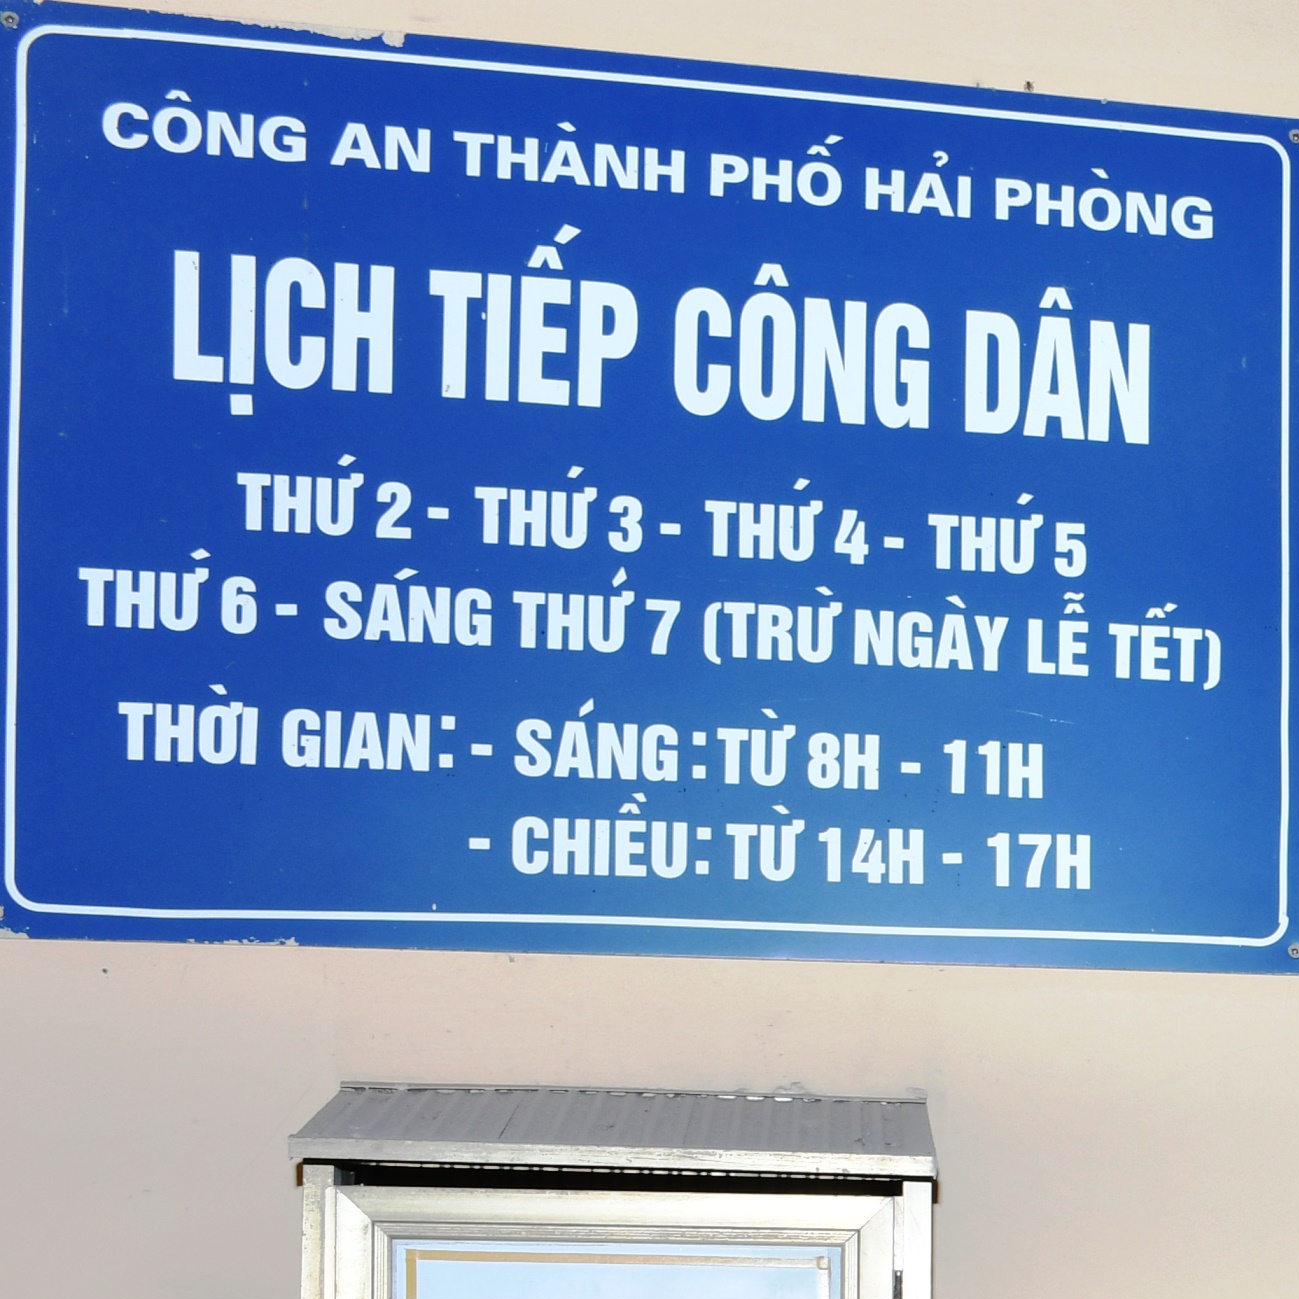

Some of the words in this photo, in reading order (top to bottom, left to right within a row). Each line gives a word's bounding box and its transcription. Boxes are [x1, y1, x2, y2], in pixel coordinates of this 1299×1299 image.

[103, 90, 306, 161] CÔNG
[331, 123, 430, 172] AN
[454, 123, 684, 193] THÀNH
[710, 135, 842, 206] PHỐ
[866, 151, 971, 218] HẢI
[996, 169, 1213, 239] PHÒNG
[174, 251, 394, 415] LỊCH
[430, 224, 638, 407] TIẾP
[674, 263, 929, 428] CÔNG
[965, 287, 1150, 444] DÂN
[238, 454, 364, 535] THỨ
[376, 482, 411, 539] 2
[475, 466, 597, 549] THỨ
[609, 496, 642, 552] 3
[705, 478, 822, 561] THỨ
[835, 510, 868, 564] 4
[928, 493, 1043, 574] THỨ
[1055, 522, 1086, 577] 5
[79, 549, 208, 631] THỨ
[222, 577, 256, 634] 6
[324, 568, 491, 646] SÁNG
[513, 567, 634, 652] THỨ
[646, 599, 680, 654] 7
[704, 586, 842, 664] (TRỪ
[854, 595, 1008, 671] NGÀY
[1028, 592, 1088, 676] LỄ
[1109, 603, 1220, 690] TẾT)
[119, 685, 258, 764] THỜI
[282, 709, 455, 771] GIAN:
[808, 733, 879, 790] 8H
[944, 740, 1043, 798] 11H
[818, 828, 924, 884] 14H
[987, 833, 1090, 889] 17H
